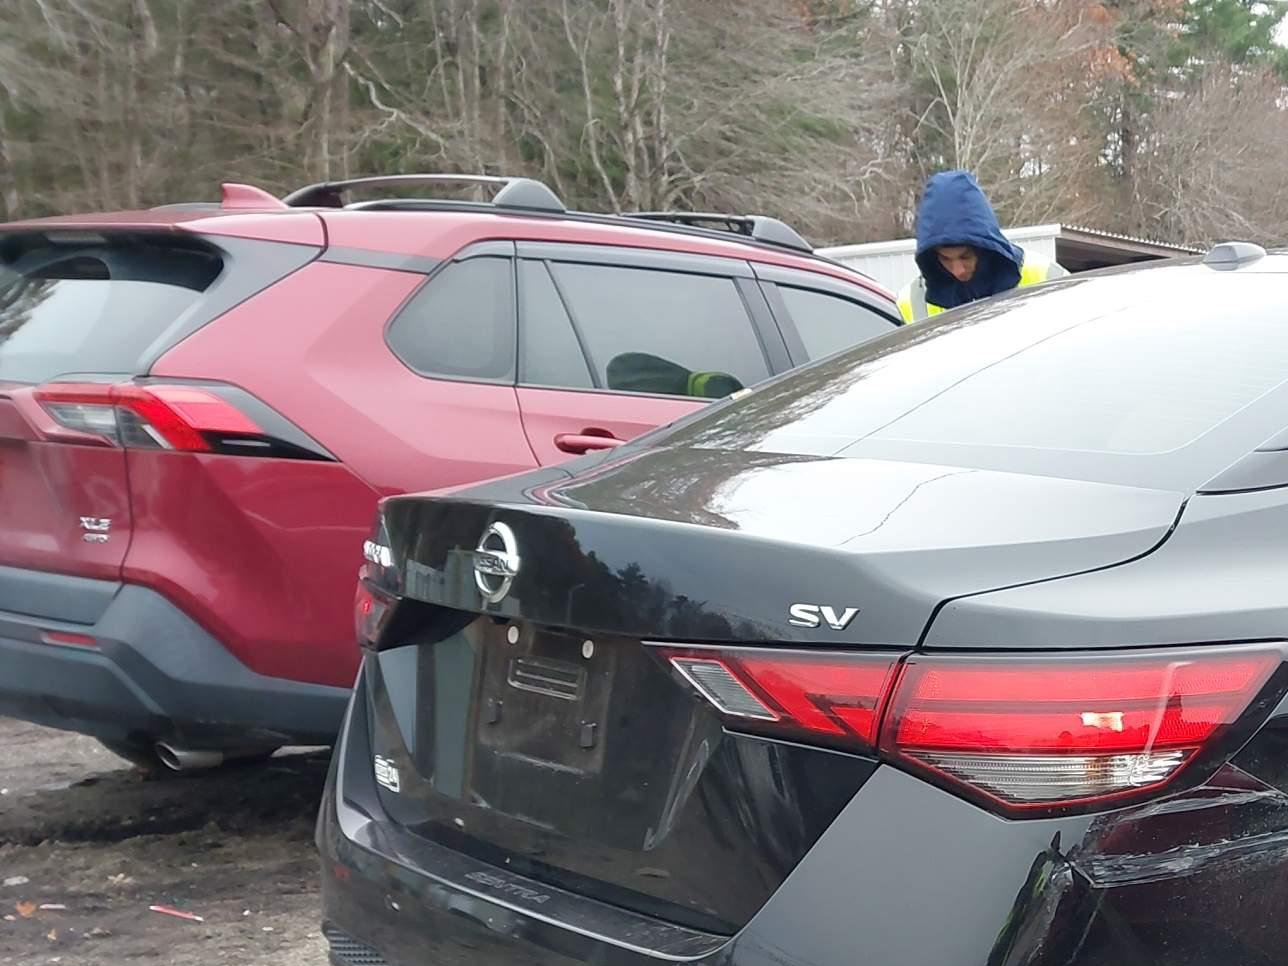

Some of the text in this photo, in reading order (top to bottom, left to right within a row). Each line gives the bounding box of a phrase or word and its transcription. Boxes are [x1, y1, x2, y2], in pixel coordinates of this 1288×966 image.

[79, 516, 112, 530] XLE
[788, 603, 860, 631] SV
[464, 871, 551, 904] SENTRA
